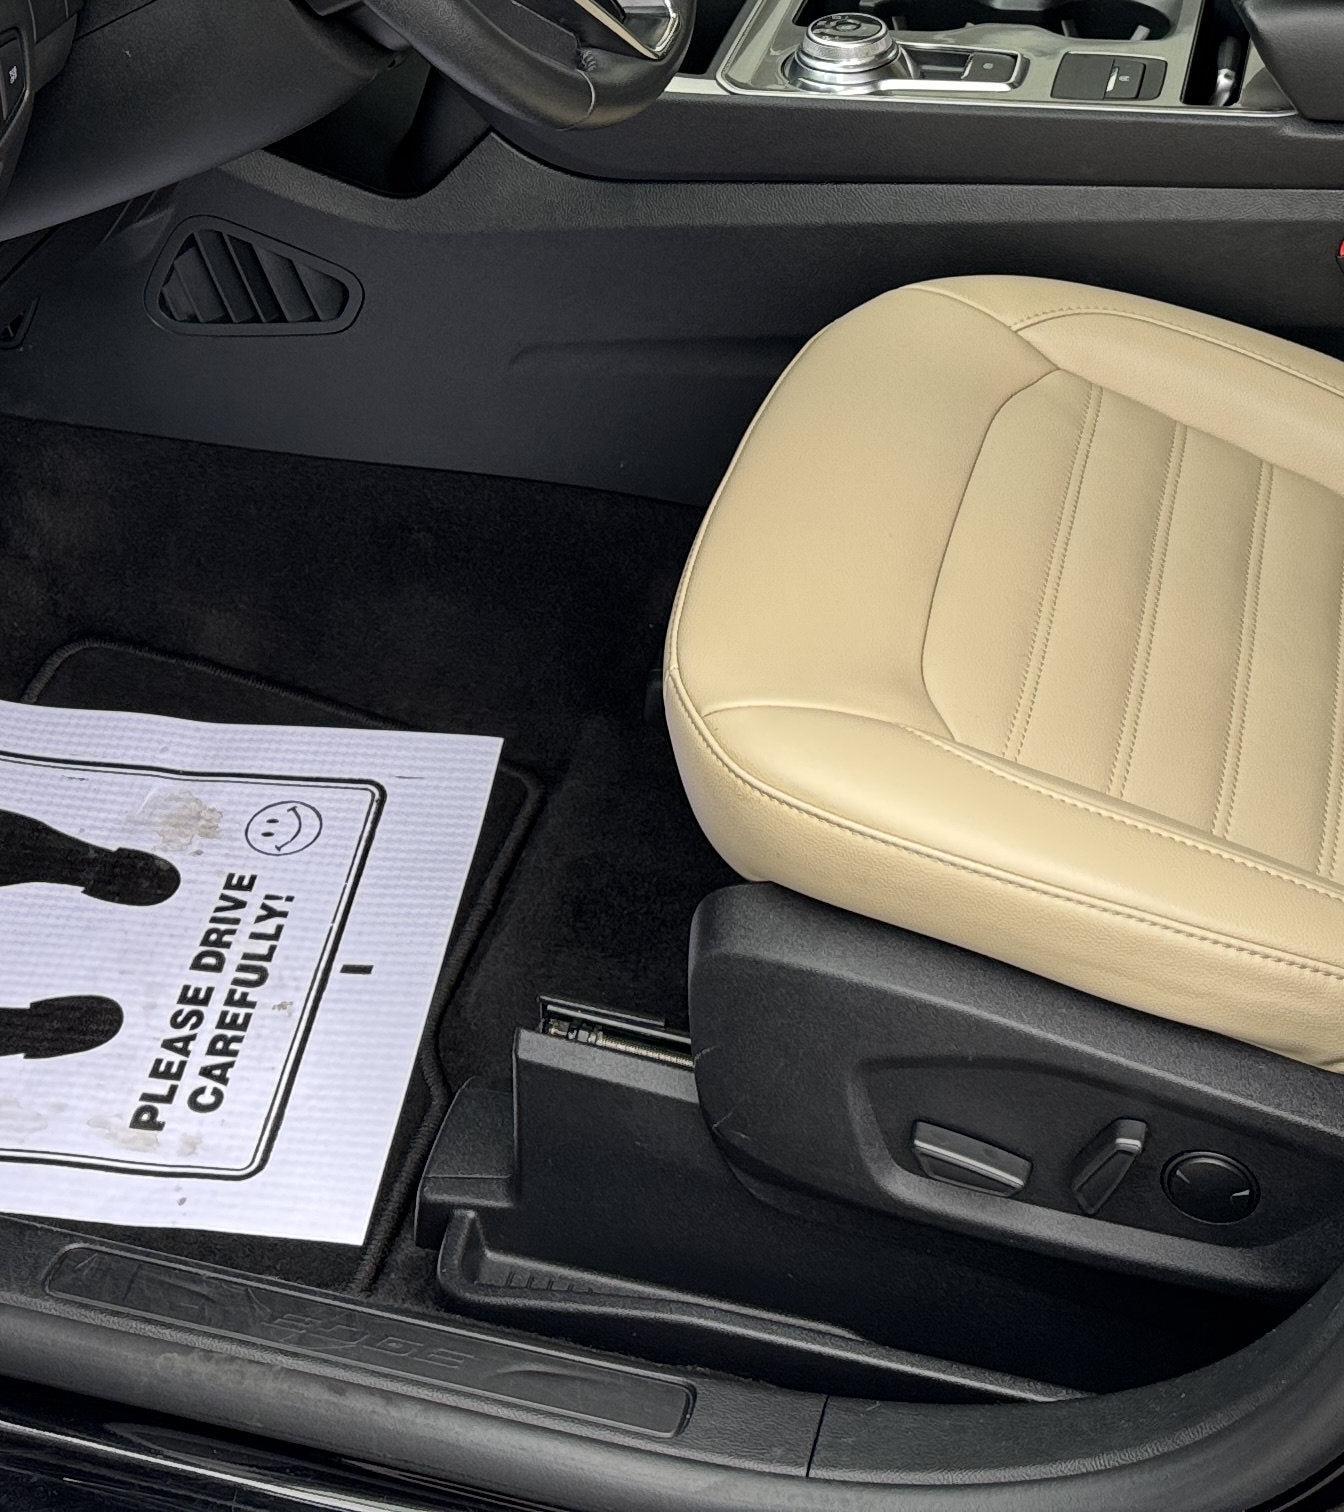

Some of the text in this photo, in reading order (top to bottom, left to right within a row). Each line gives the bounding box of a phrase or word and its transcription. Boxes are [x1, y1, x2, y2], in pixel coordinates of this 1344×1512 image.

[129, 872, 258, 1132] PLEASE DRIVE
[187, 893, 295, 1114] CAREFULLY!
[259, 1310, 478, 1371] EDGE
